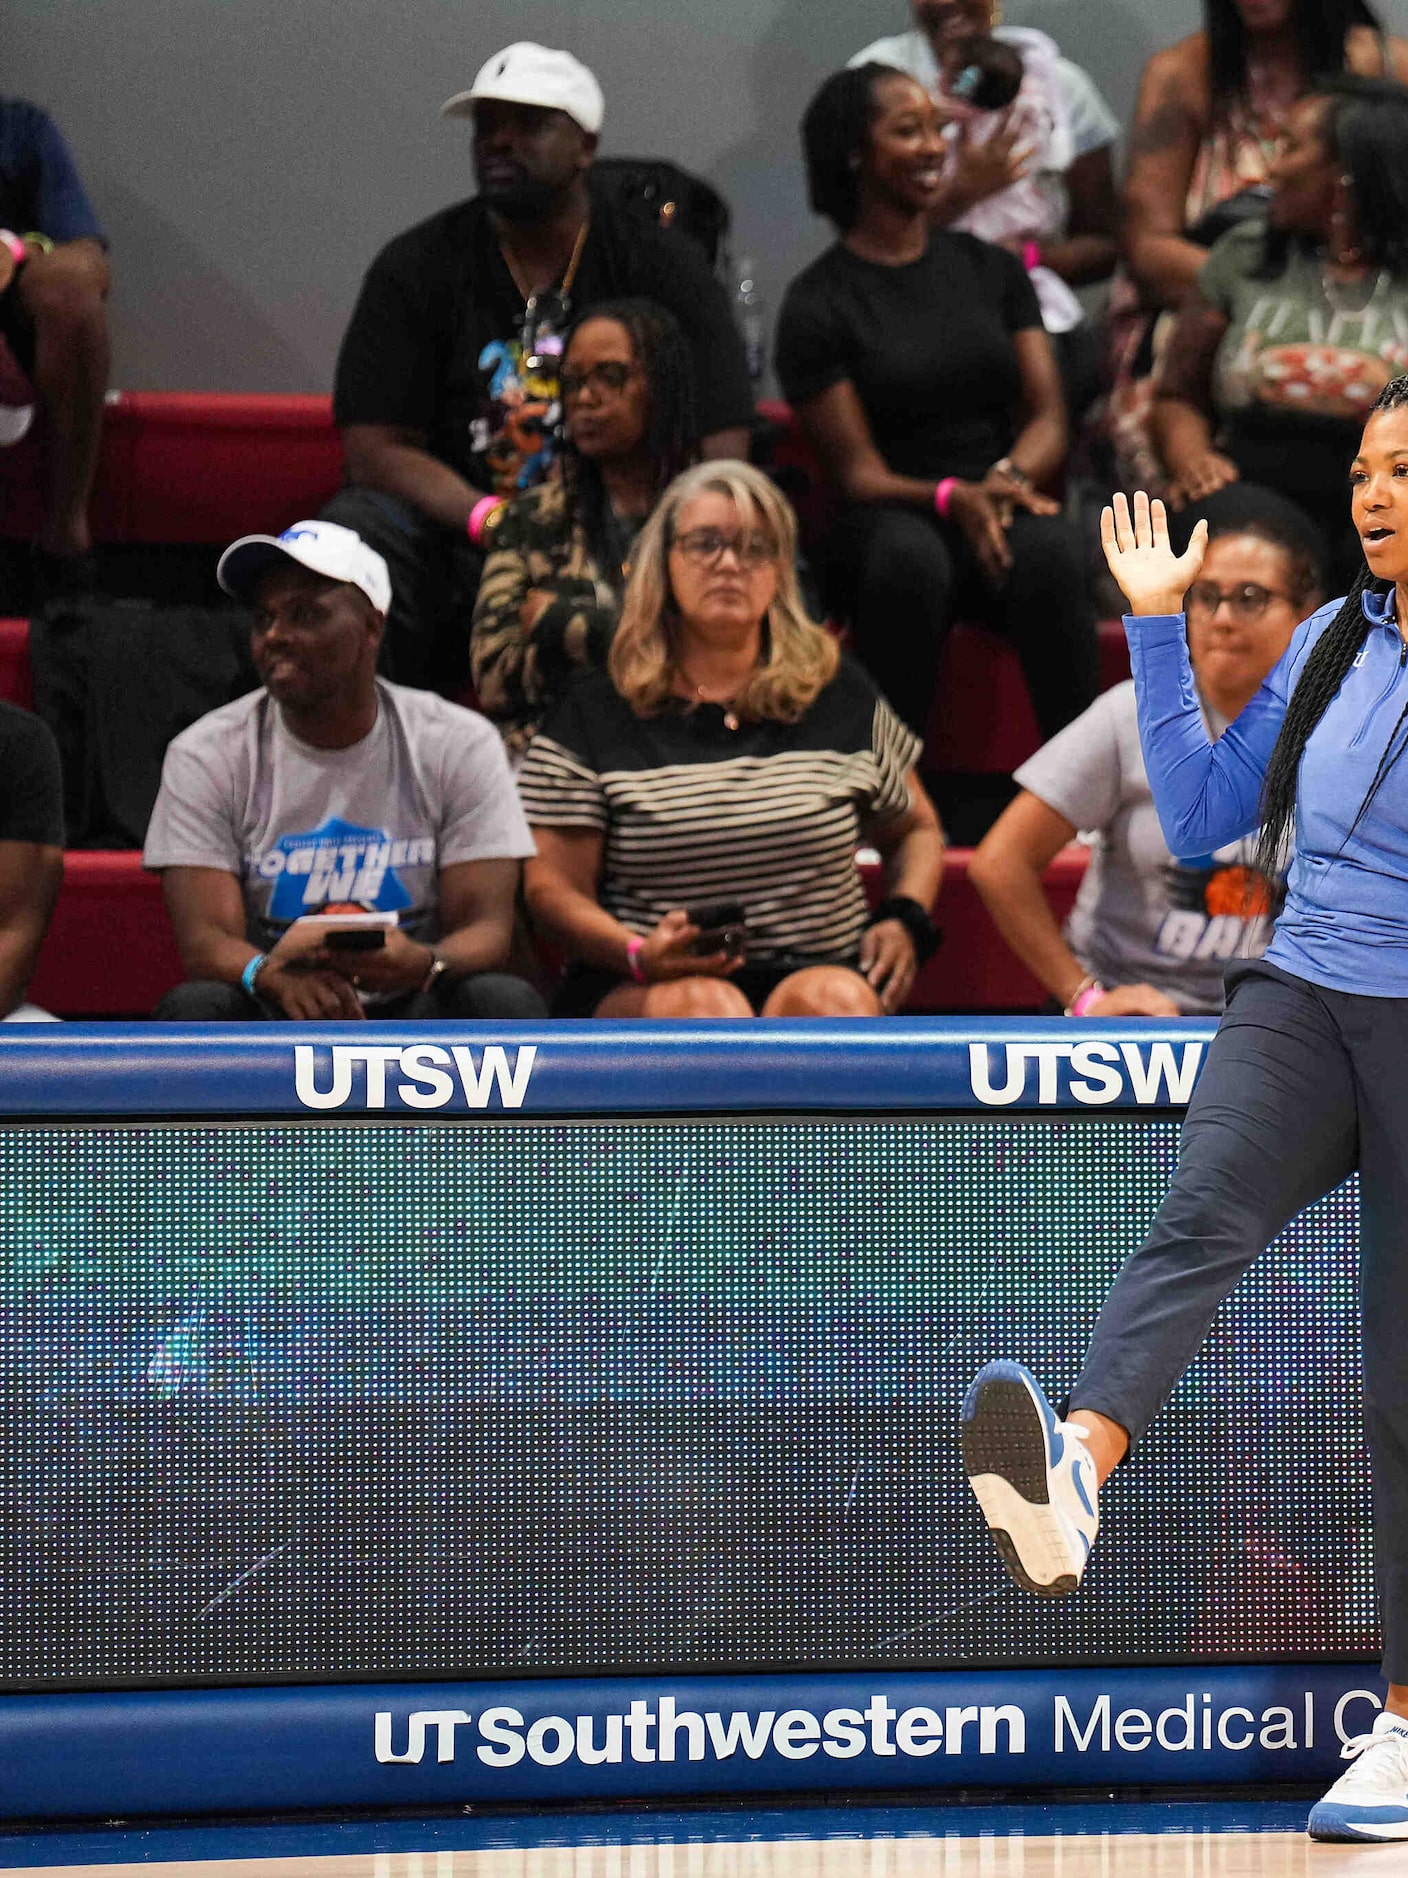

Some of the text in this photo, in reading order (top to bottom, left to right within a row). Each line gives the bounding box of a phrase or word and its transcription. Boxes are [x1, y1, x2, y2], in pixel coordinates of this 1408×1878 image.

[303, 868, 385, 905] WE
[1157, 911, 1269, 958] BAL
[294, 1045, 537, 1108] UTSW
[969, 1042, 1205, 1105] UTSW
[1054, 1692, 1314, 1753] Medical
